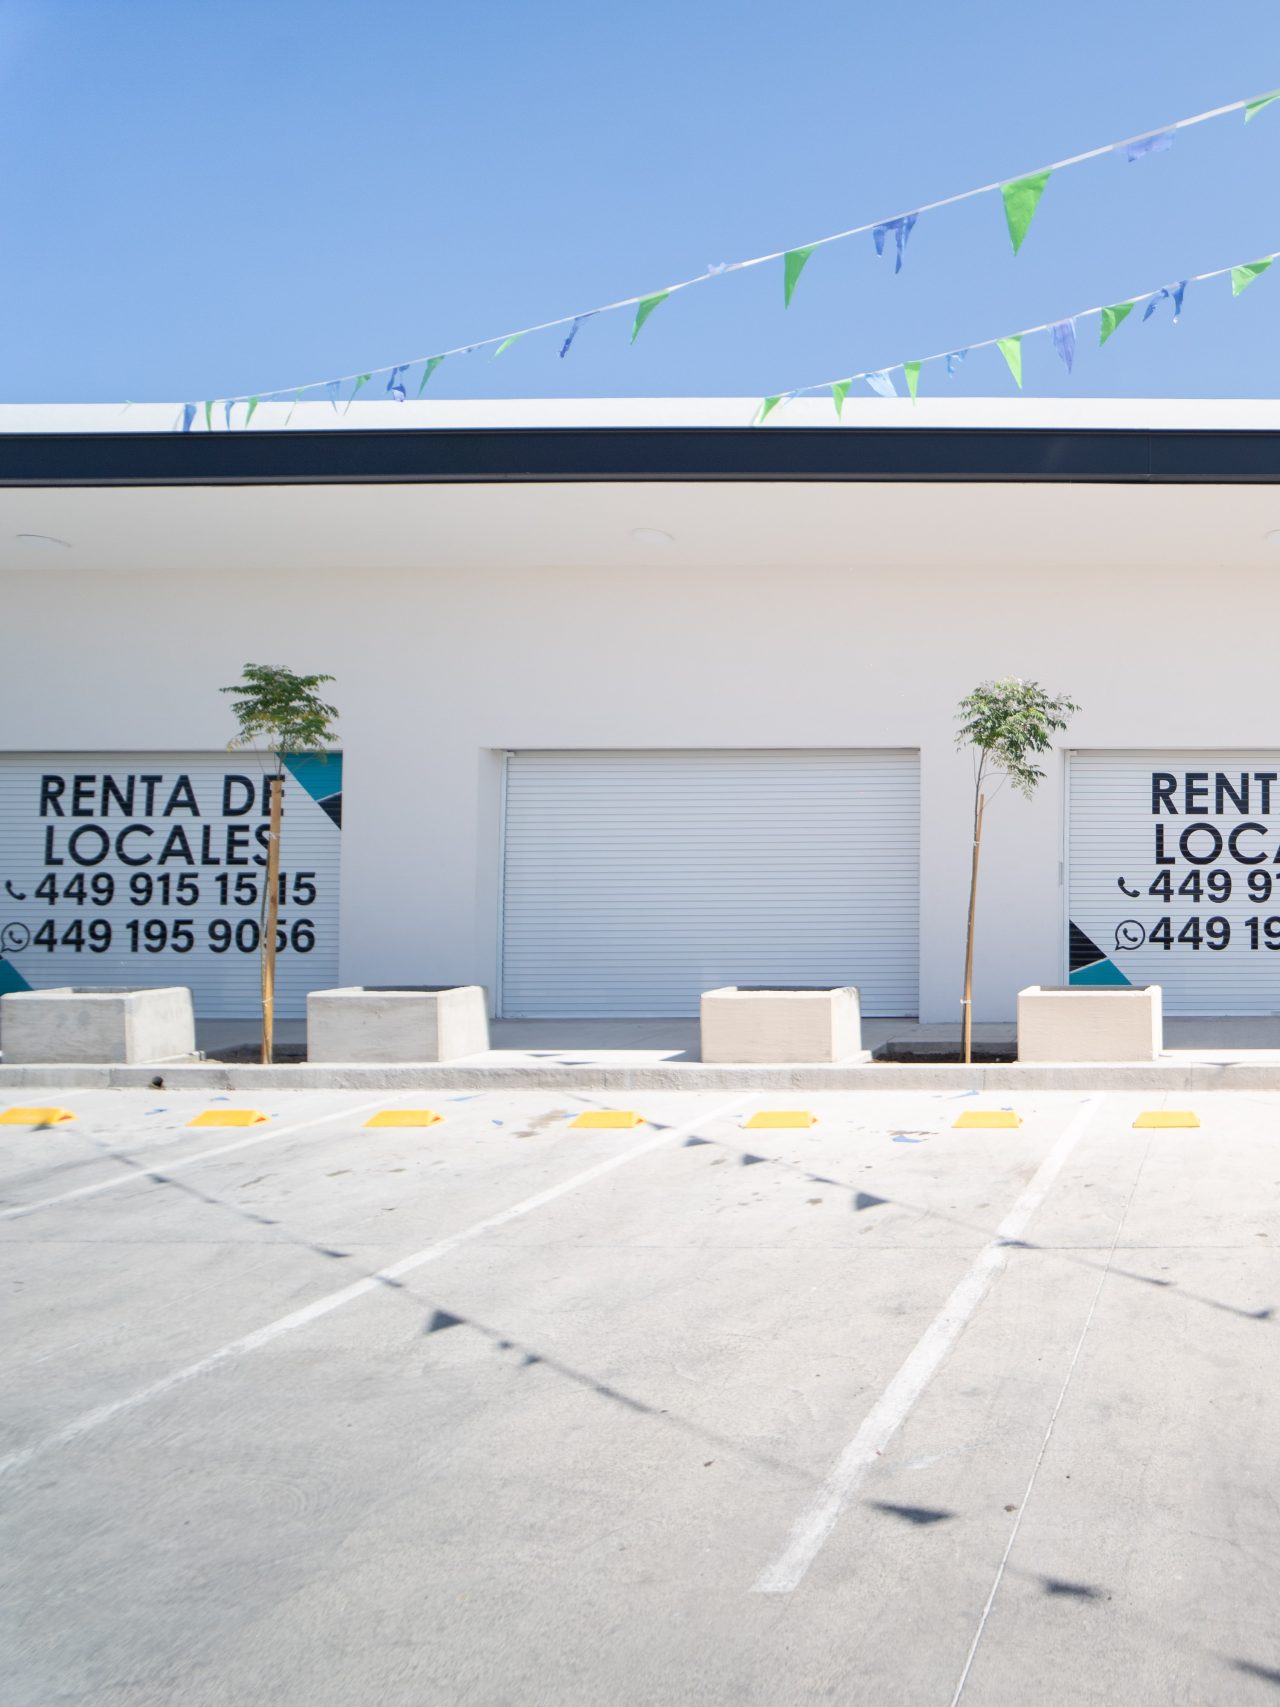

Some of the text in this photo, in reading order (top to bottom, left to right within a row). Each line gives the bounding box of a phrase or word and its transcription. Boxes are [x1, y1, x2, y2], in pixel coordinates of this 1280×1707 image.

[39, 775, 286, 817] RENTA DE
[34, 872, 317, 906] 449 915 15 15
[1148, 869, 1232, 904] 449
[33, 918, 316, 953] 449 195 9056
[1148, 915, 1231, 951] 449
